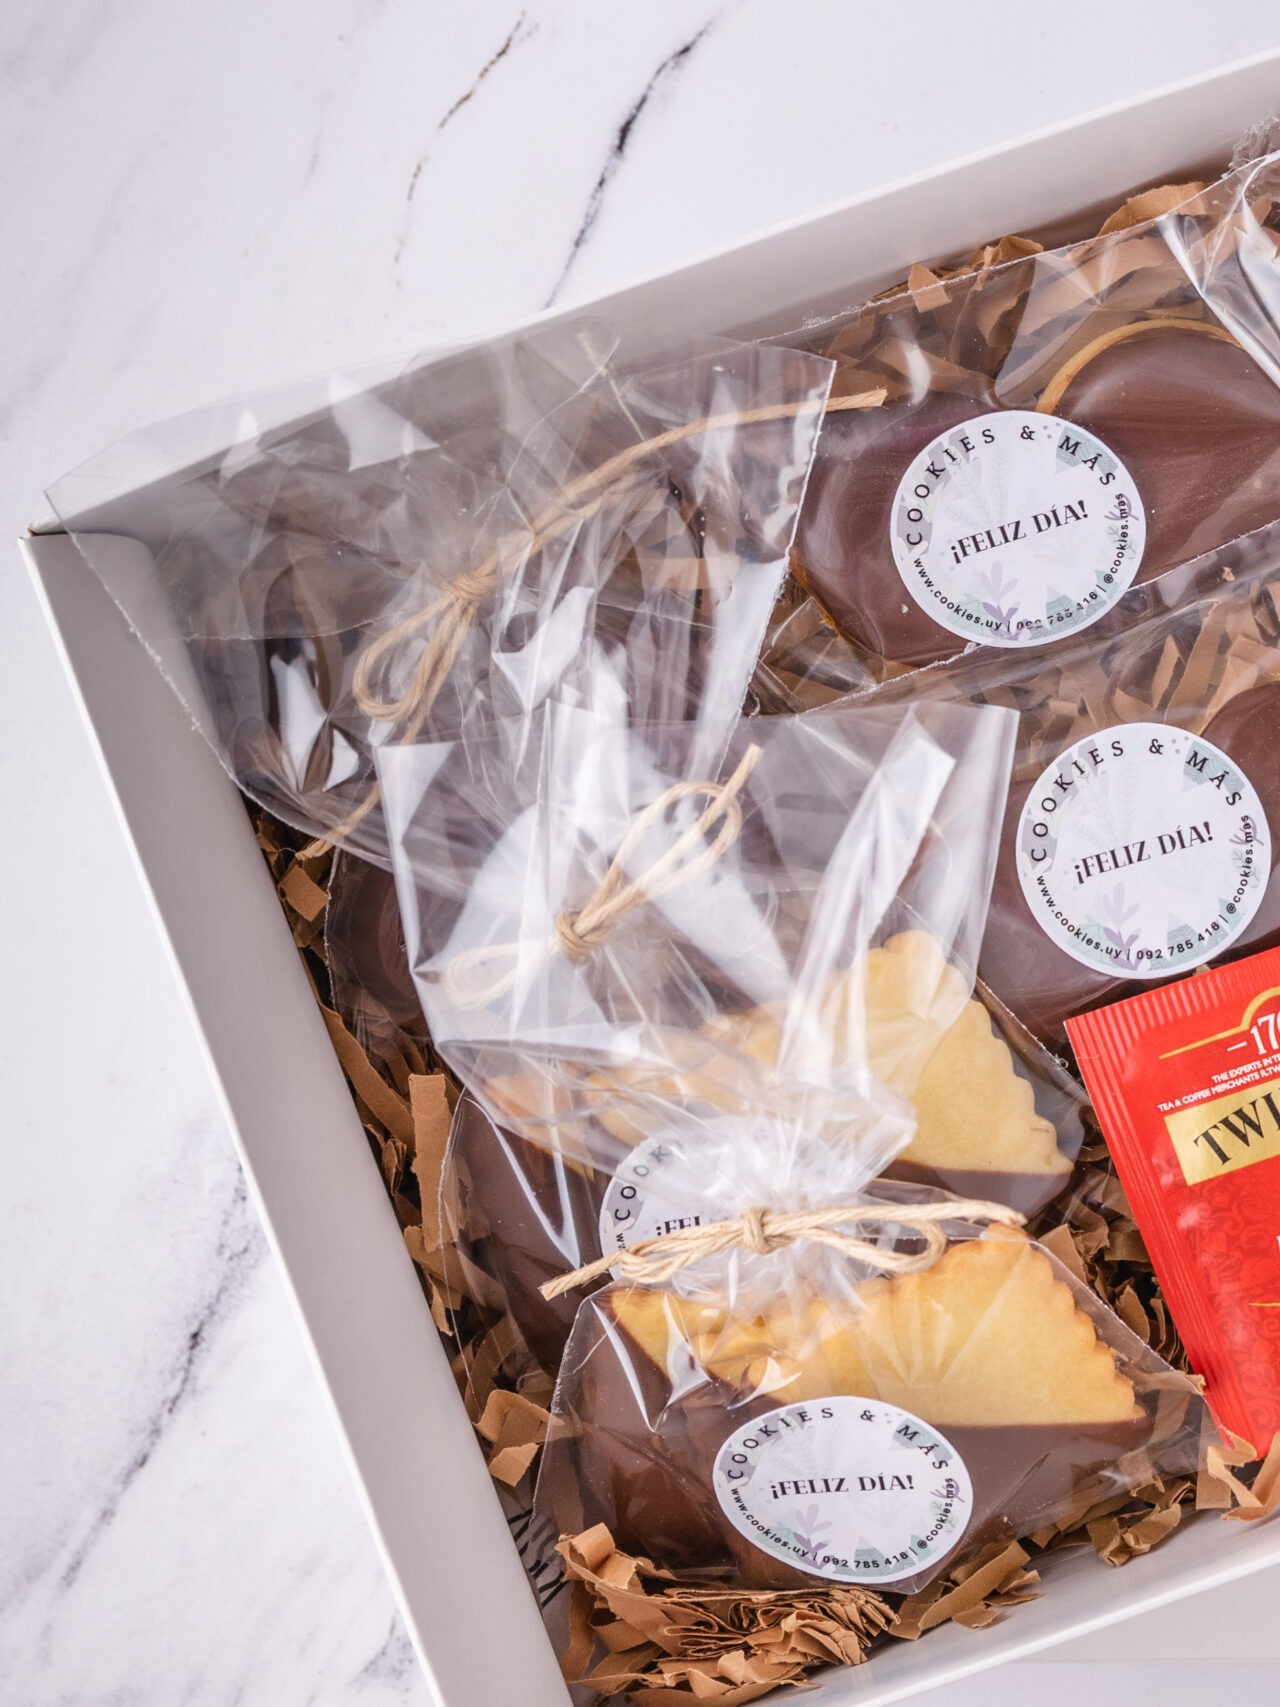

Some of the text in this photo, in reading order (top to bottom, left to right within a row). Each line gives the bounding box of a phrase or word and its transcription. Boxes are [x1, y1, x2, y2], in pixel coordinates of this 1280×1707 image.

[906, 425, 1117, 546] COOKIES & MÁS
[913, 557, 1003, 632] www.cookies.uy
[1103, 493, 1129, 585] @cookies.mas
[950, 499, 1090, 565] ¡FELIZ DÍA!
[1030, 738, 1242, 862] COOKIES & MÁS
[1035, 874, 1124, 959] www.cookies.uy
[1136, 949, 1163, 960] 092
[1168, 939, 1194, 957] 785
[1197, 922, 1220, 942] 416
[1226, 814, 1253, 915] @cookies.mas
[1073, 820, 1214, 885] ¡FELIZ DÍA!
[1157, 1100, 1175, 1112] TEA
[1175, 1098, 1182, 1107] &
[1182, 1087, 1211, 1105] COFFEE
[1211, 1071, 1260, 1096] MERCHANTS
[1211, 1071, 1229, 1084] THE
[1229, 1060, 1263, 1079] EXPERTS
[1262, 1057, 1273, 1067] IN
[727, 1407, 949, 1480] COOKIES & MÁS
[770, 1472, 915, 1500] ¡FELIZ DÍA!
[730, 1488, 810, 1558] www.cookies.uy
[822, 1555, 849, 1568] 092
[854, 1560, 880, 1569] 785
[884, 1551, 909, 1566] 416
[917, 1478, 954, 1550] @cookies.mas
